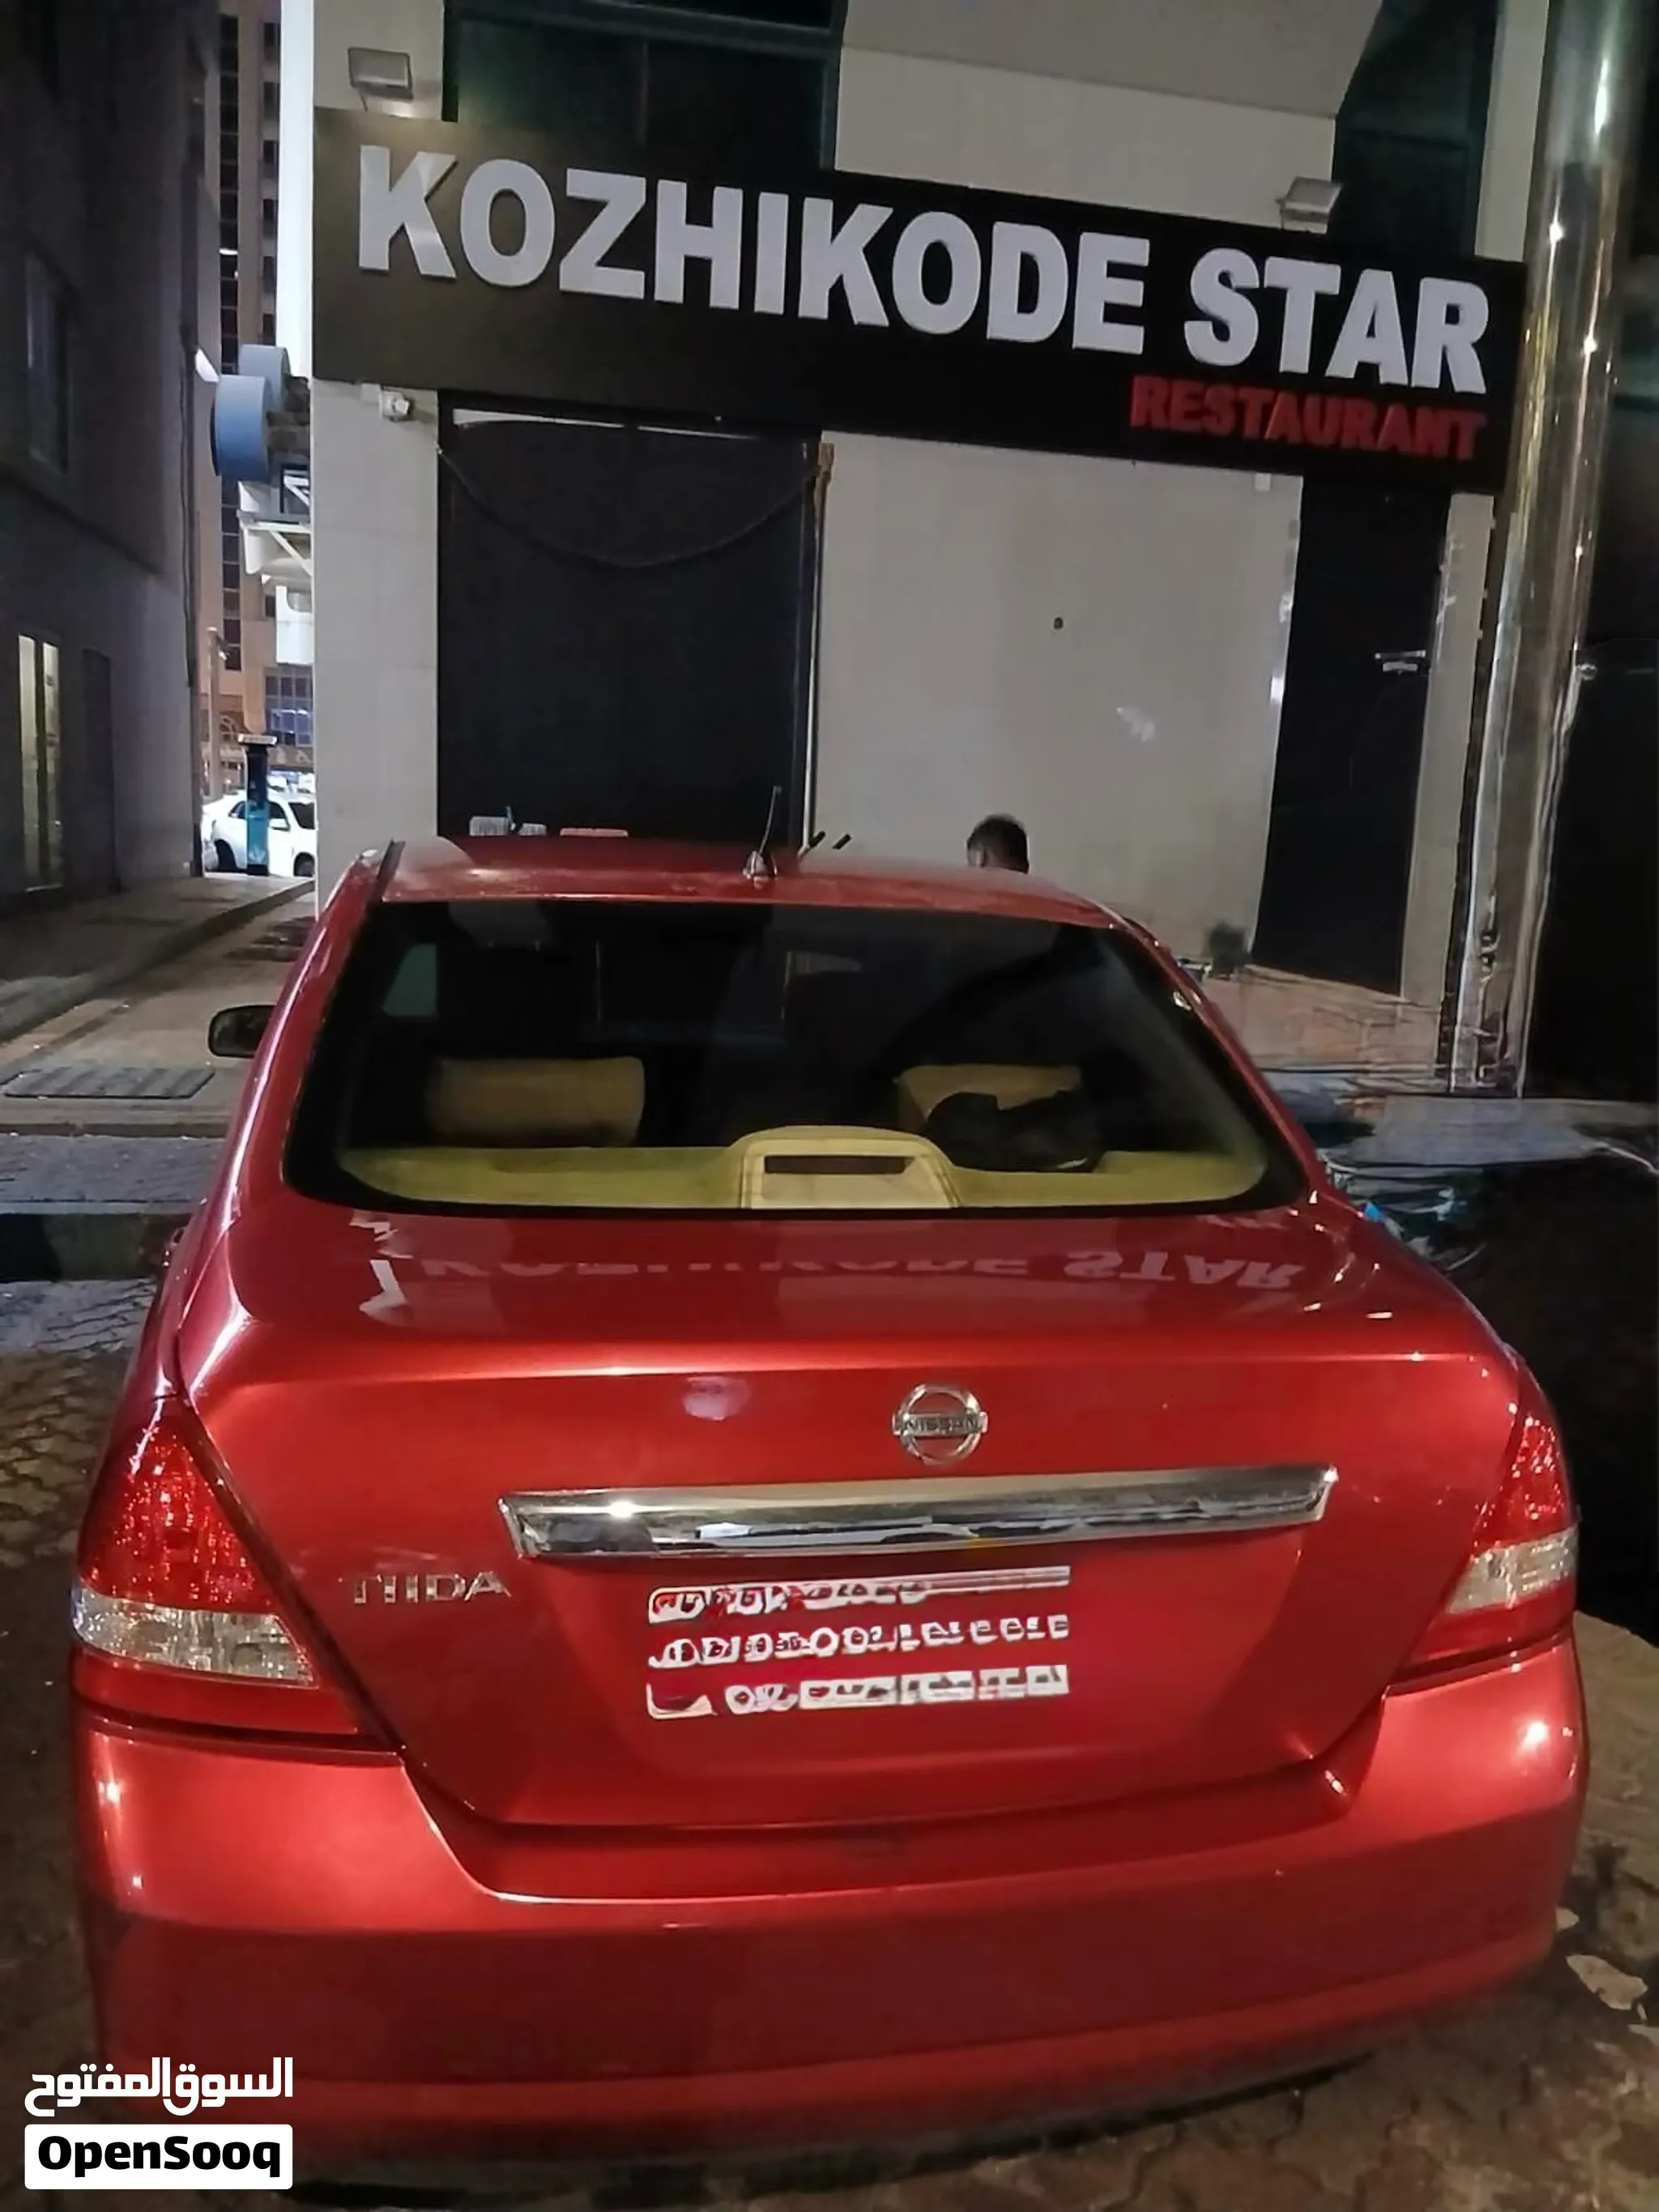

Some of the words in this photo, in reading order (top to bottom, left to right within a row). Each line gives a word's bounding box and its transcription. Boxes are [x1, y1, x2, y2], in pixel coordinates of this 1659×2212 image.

[358, 144, 1149, 355] KOZHIKODE
[1184, 248, 1490, 394] STAR
[1131, 375, 1486, 460] RESTAURANT
